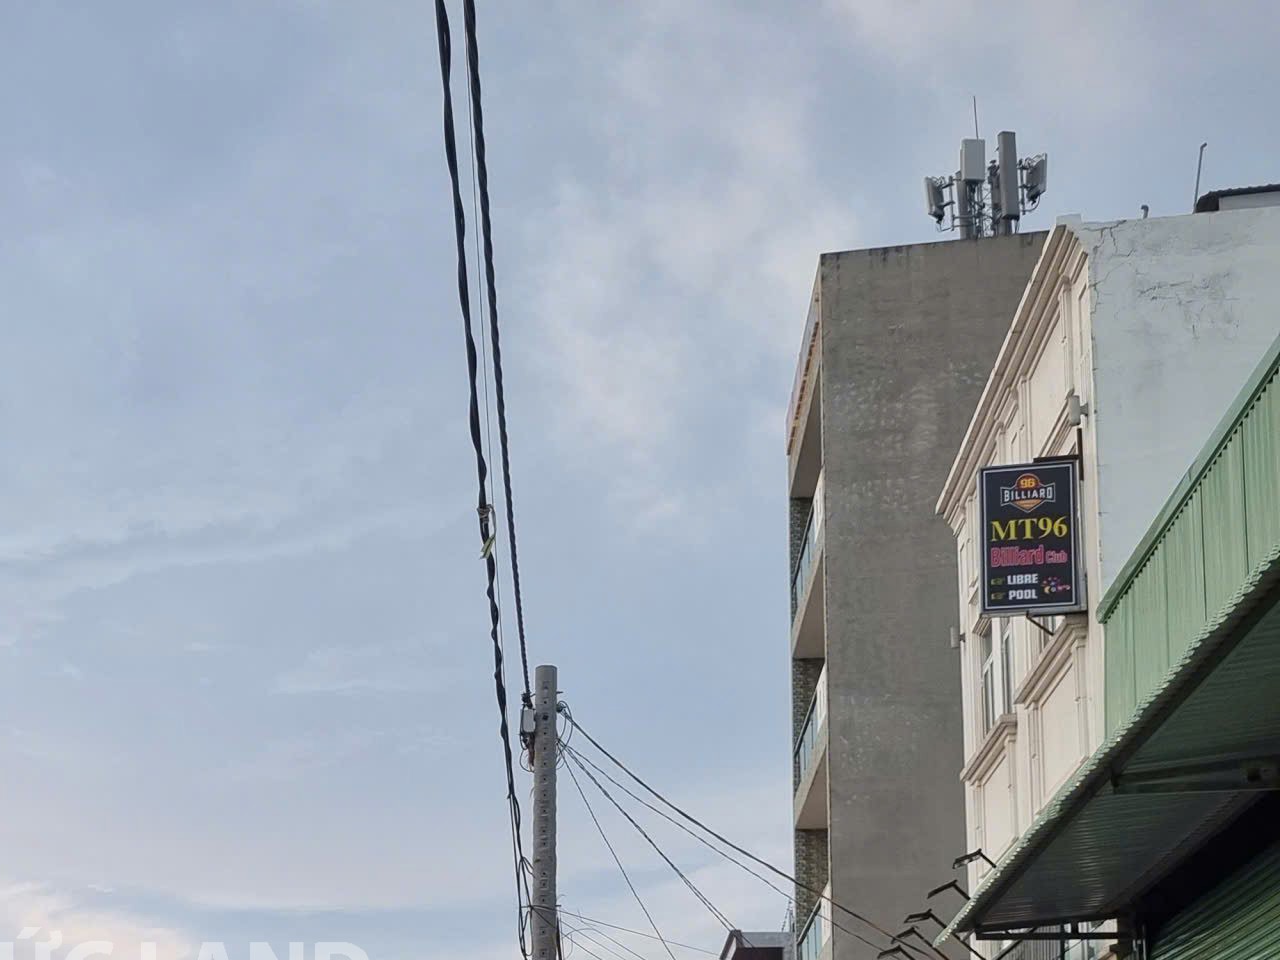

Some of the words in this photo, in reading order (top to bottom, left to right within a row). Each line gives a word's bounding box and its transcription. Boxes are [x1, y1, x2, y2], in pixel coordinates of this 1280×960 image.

[1004, 486, 1053, 502] BILLIARD
[990, 516, 1068, 542] MT96
[990, 544, 1045, 568] Billiard
[1045, 550, 1068, 564] Club
[1007, 574, 1038, 585] LIBRE
[1008, 589, 1038, 600] POOL
